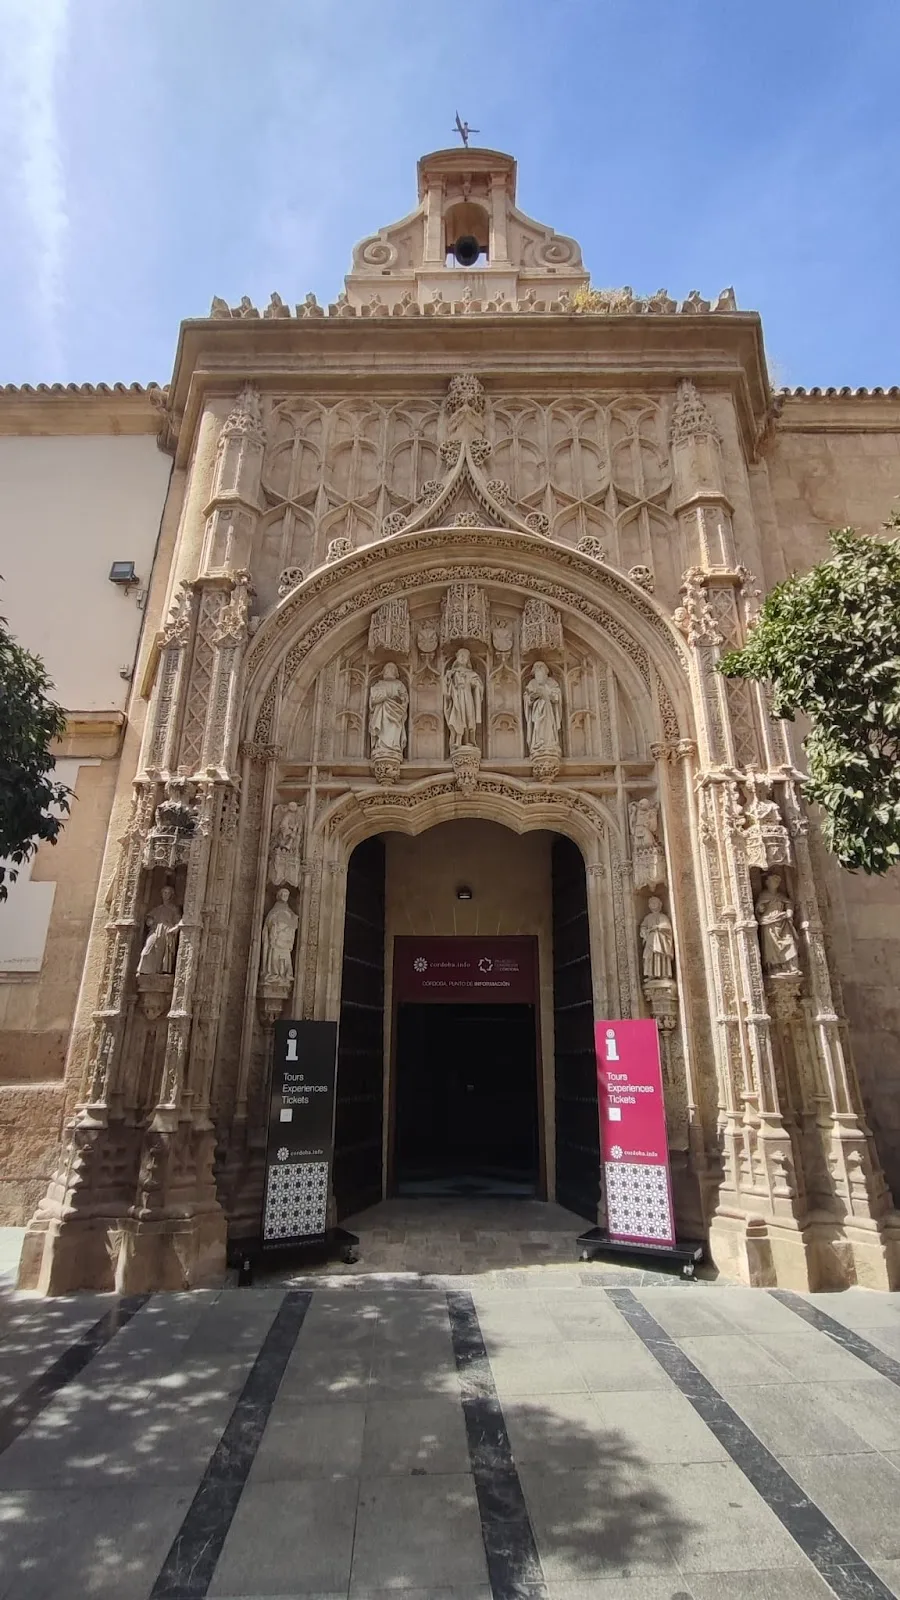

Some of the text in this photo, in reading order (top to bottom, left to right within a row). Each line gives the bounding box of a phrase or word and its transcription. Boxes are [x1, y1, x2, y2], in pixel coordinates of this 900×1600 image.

[283, 1072, 304, 1081] Tours
[606, 1072, 628, 1081] Tours
[282, 1084, 328, 1094] Experiences
[607, 1083, 654, 1093] Experiences
[282, 1095, 309, 1104] Tickets
[608, 1094, 636, 1104] Tickets
[624, 1149, 658, 1157] cordoba.info
